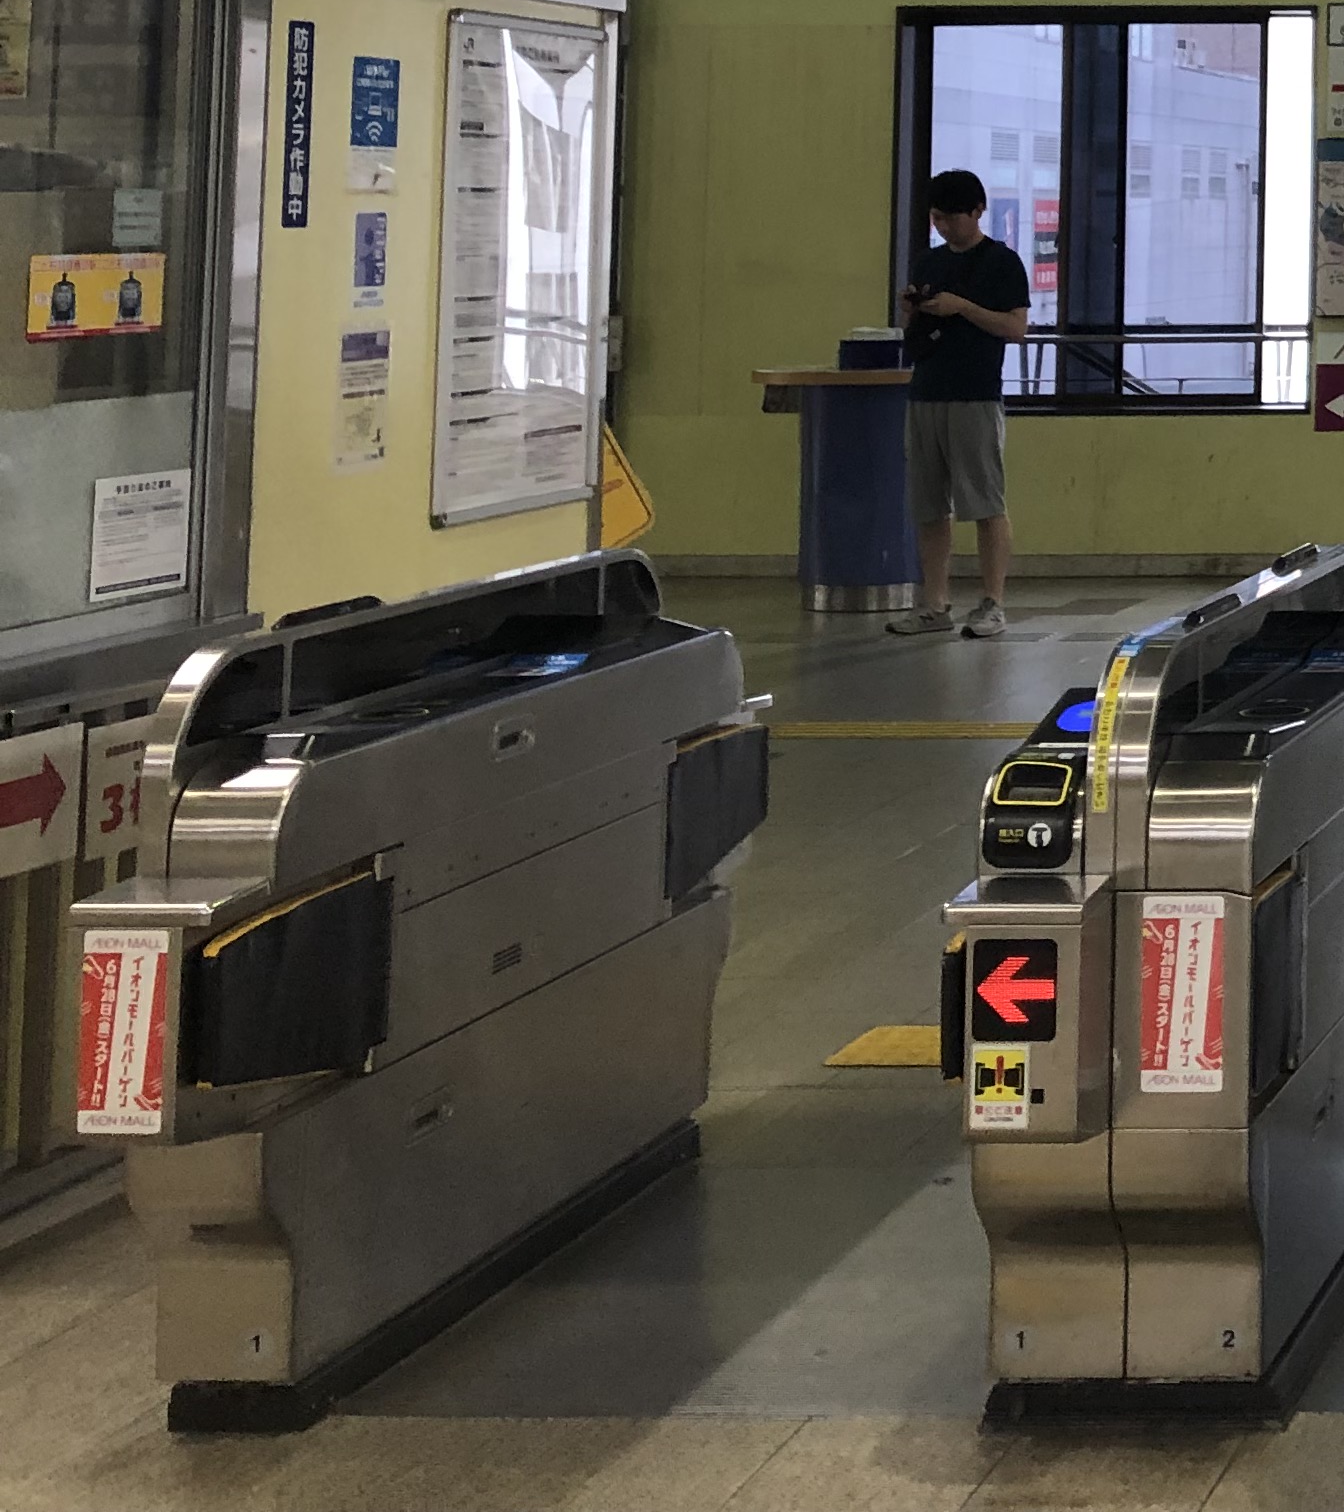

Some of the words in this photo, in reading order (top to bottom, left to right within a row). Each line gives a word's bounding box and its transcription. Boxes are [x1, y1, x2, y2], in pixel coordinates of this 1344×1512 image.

[250, 1334, 260, 1353] 1
[1017, 1331, 1025, 1349] 1
[1222, 1329, 1235, 1348] 2
